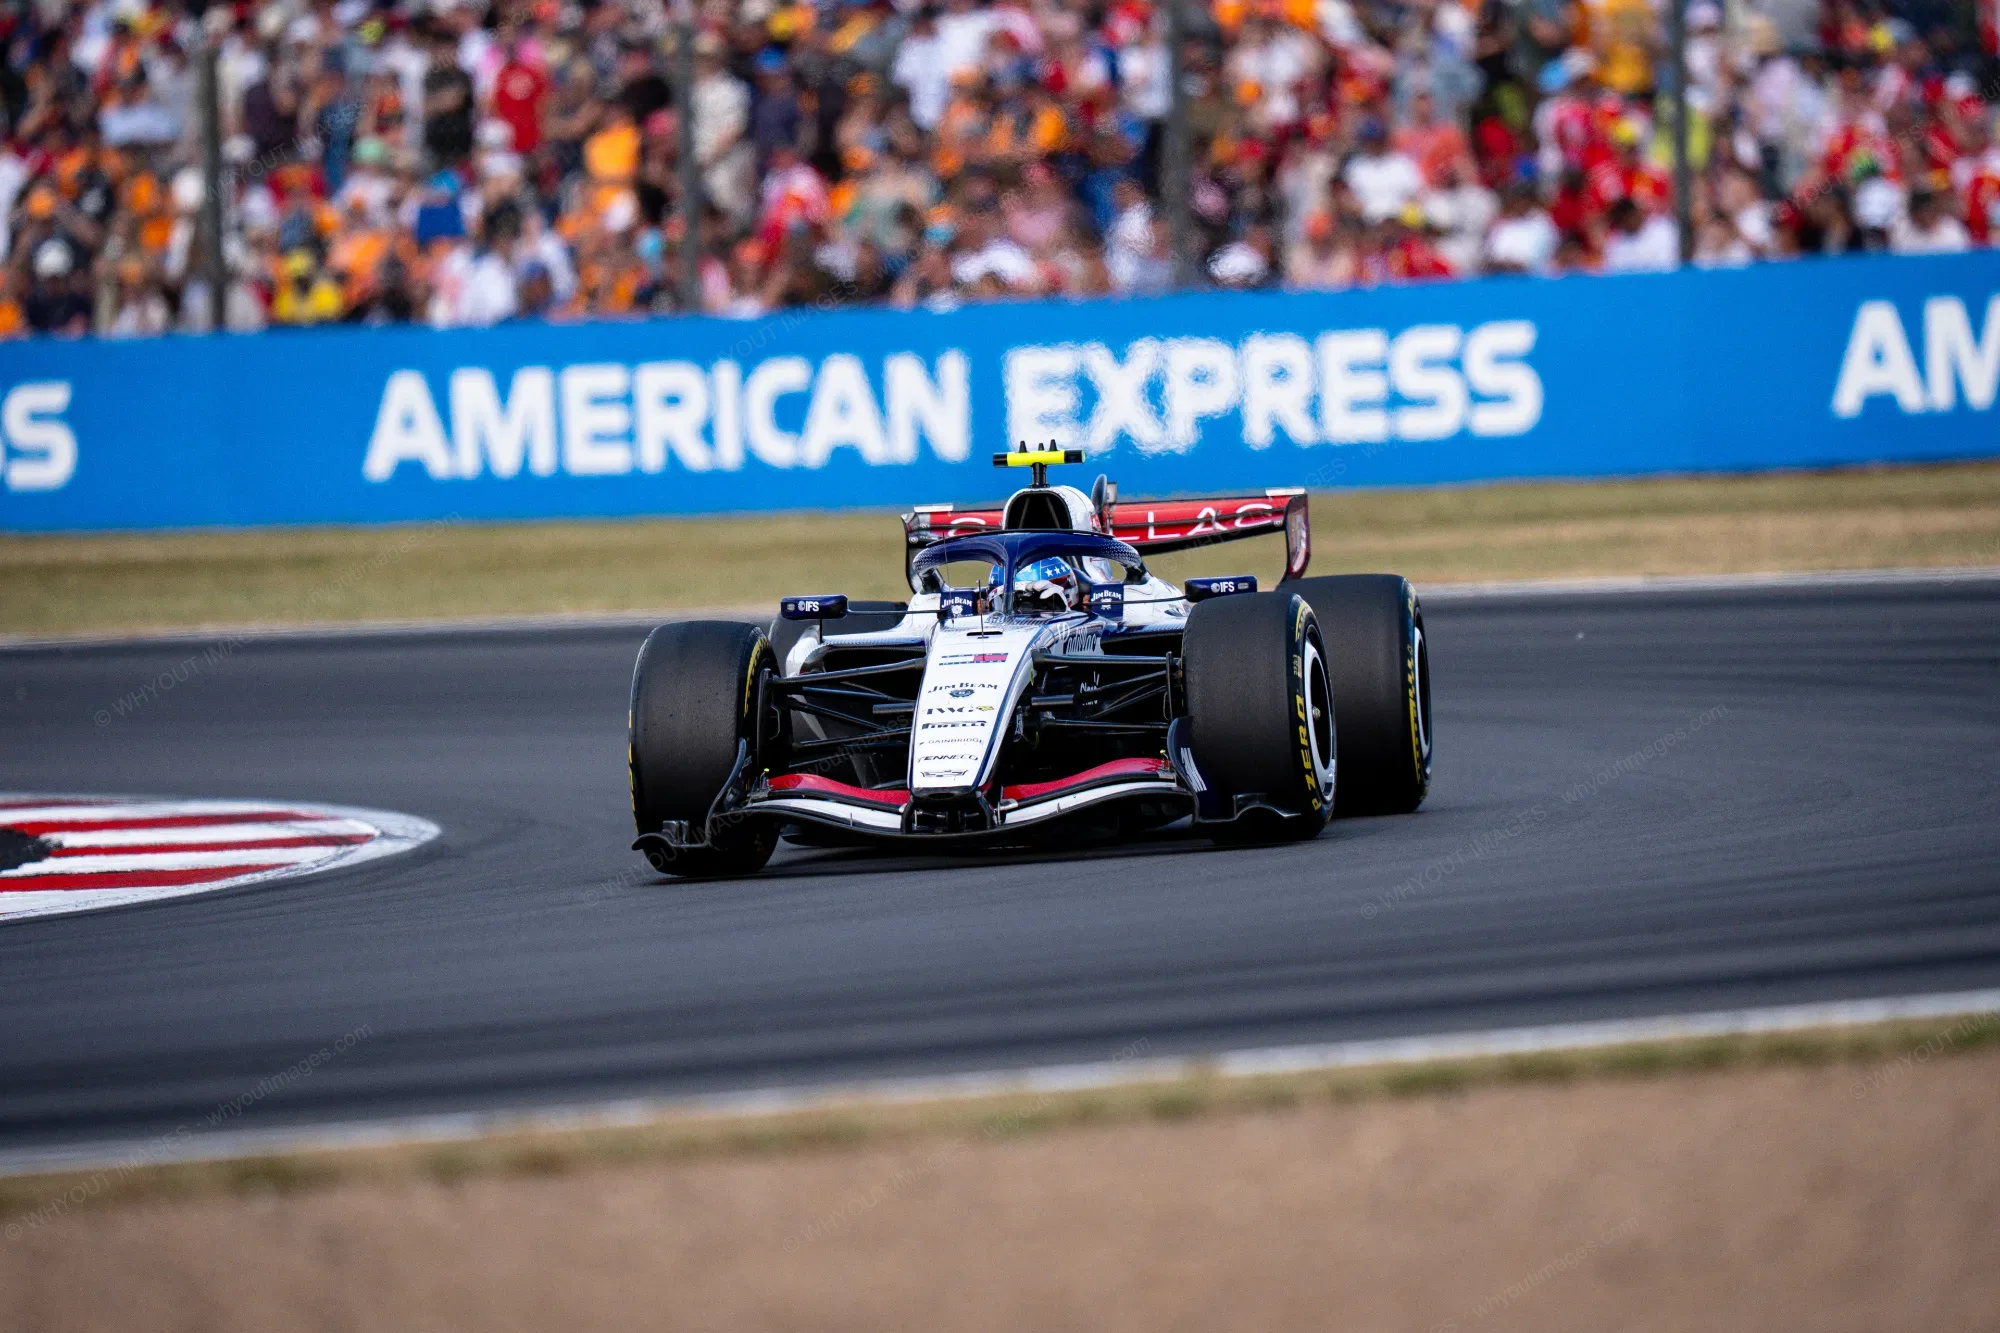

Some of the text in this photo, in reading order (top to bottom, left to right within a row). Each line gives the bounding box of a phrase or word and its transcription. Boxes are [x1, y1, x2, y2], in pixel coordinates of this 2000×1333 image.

[363, 319, 1544, 483] AMERICAN EXPRESS
[1830, 295, 2000, 418] AM
[0, 380, 78, 491] S
[805, 600, 819, 612] IFS
[1219, 581, 1235, 593] IFS
[1295, 694, 1316, 791] ZERO
